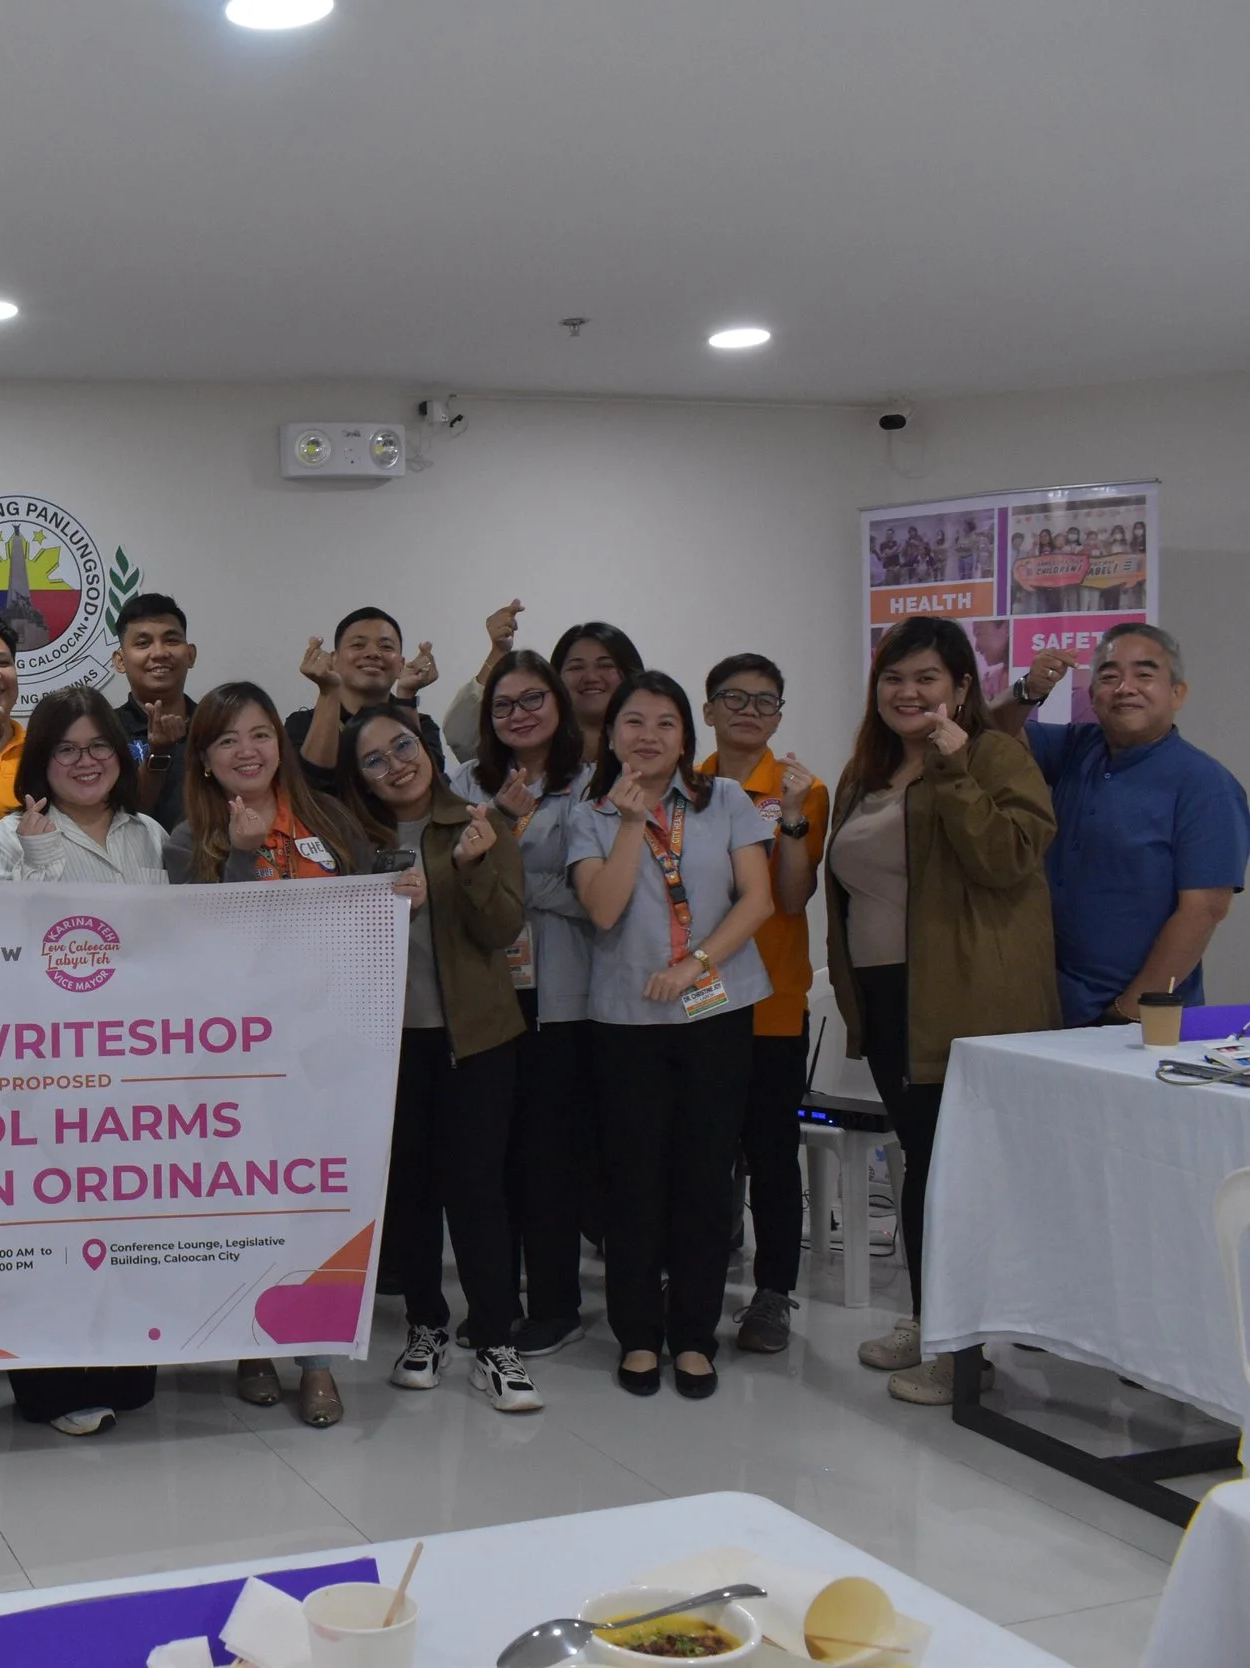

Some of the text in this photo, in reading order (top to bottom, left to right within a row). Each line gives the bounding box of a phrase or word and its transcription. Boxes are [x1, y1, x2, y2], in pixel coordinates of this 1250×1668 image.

[25, 502, 101, 617] PANLUNGSOD
[890, 592, 972, 614] HEALTH
[29, 622, 88, 669] CALOOCAN
[20, 694, 39, 705] NG
[48, 917, 116, 941] KARINA TEH
[41, 940, 120, 956] Love Caloocan
[48, 951, 111, 970] Labyu Teh
[53, 970, 109, 990] VICE MAYOR
[54, 1100, 242, 1144] HARMS
[32, 1156, 348, 1205] ORDINANCE
[16, 1247, 35, 1257] AM
[40, 1246, 53, 1256] to
[110, 1236, 286, 1252] Conference Lounge, Legislative
[16, 1260, 34, 1271] PM
[110, 1251, 241, 1266] Building, Caloocan City
